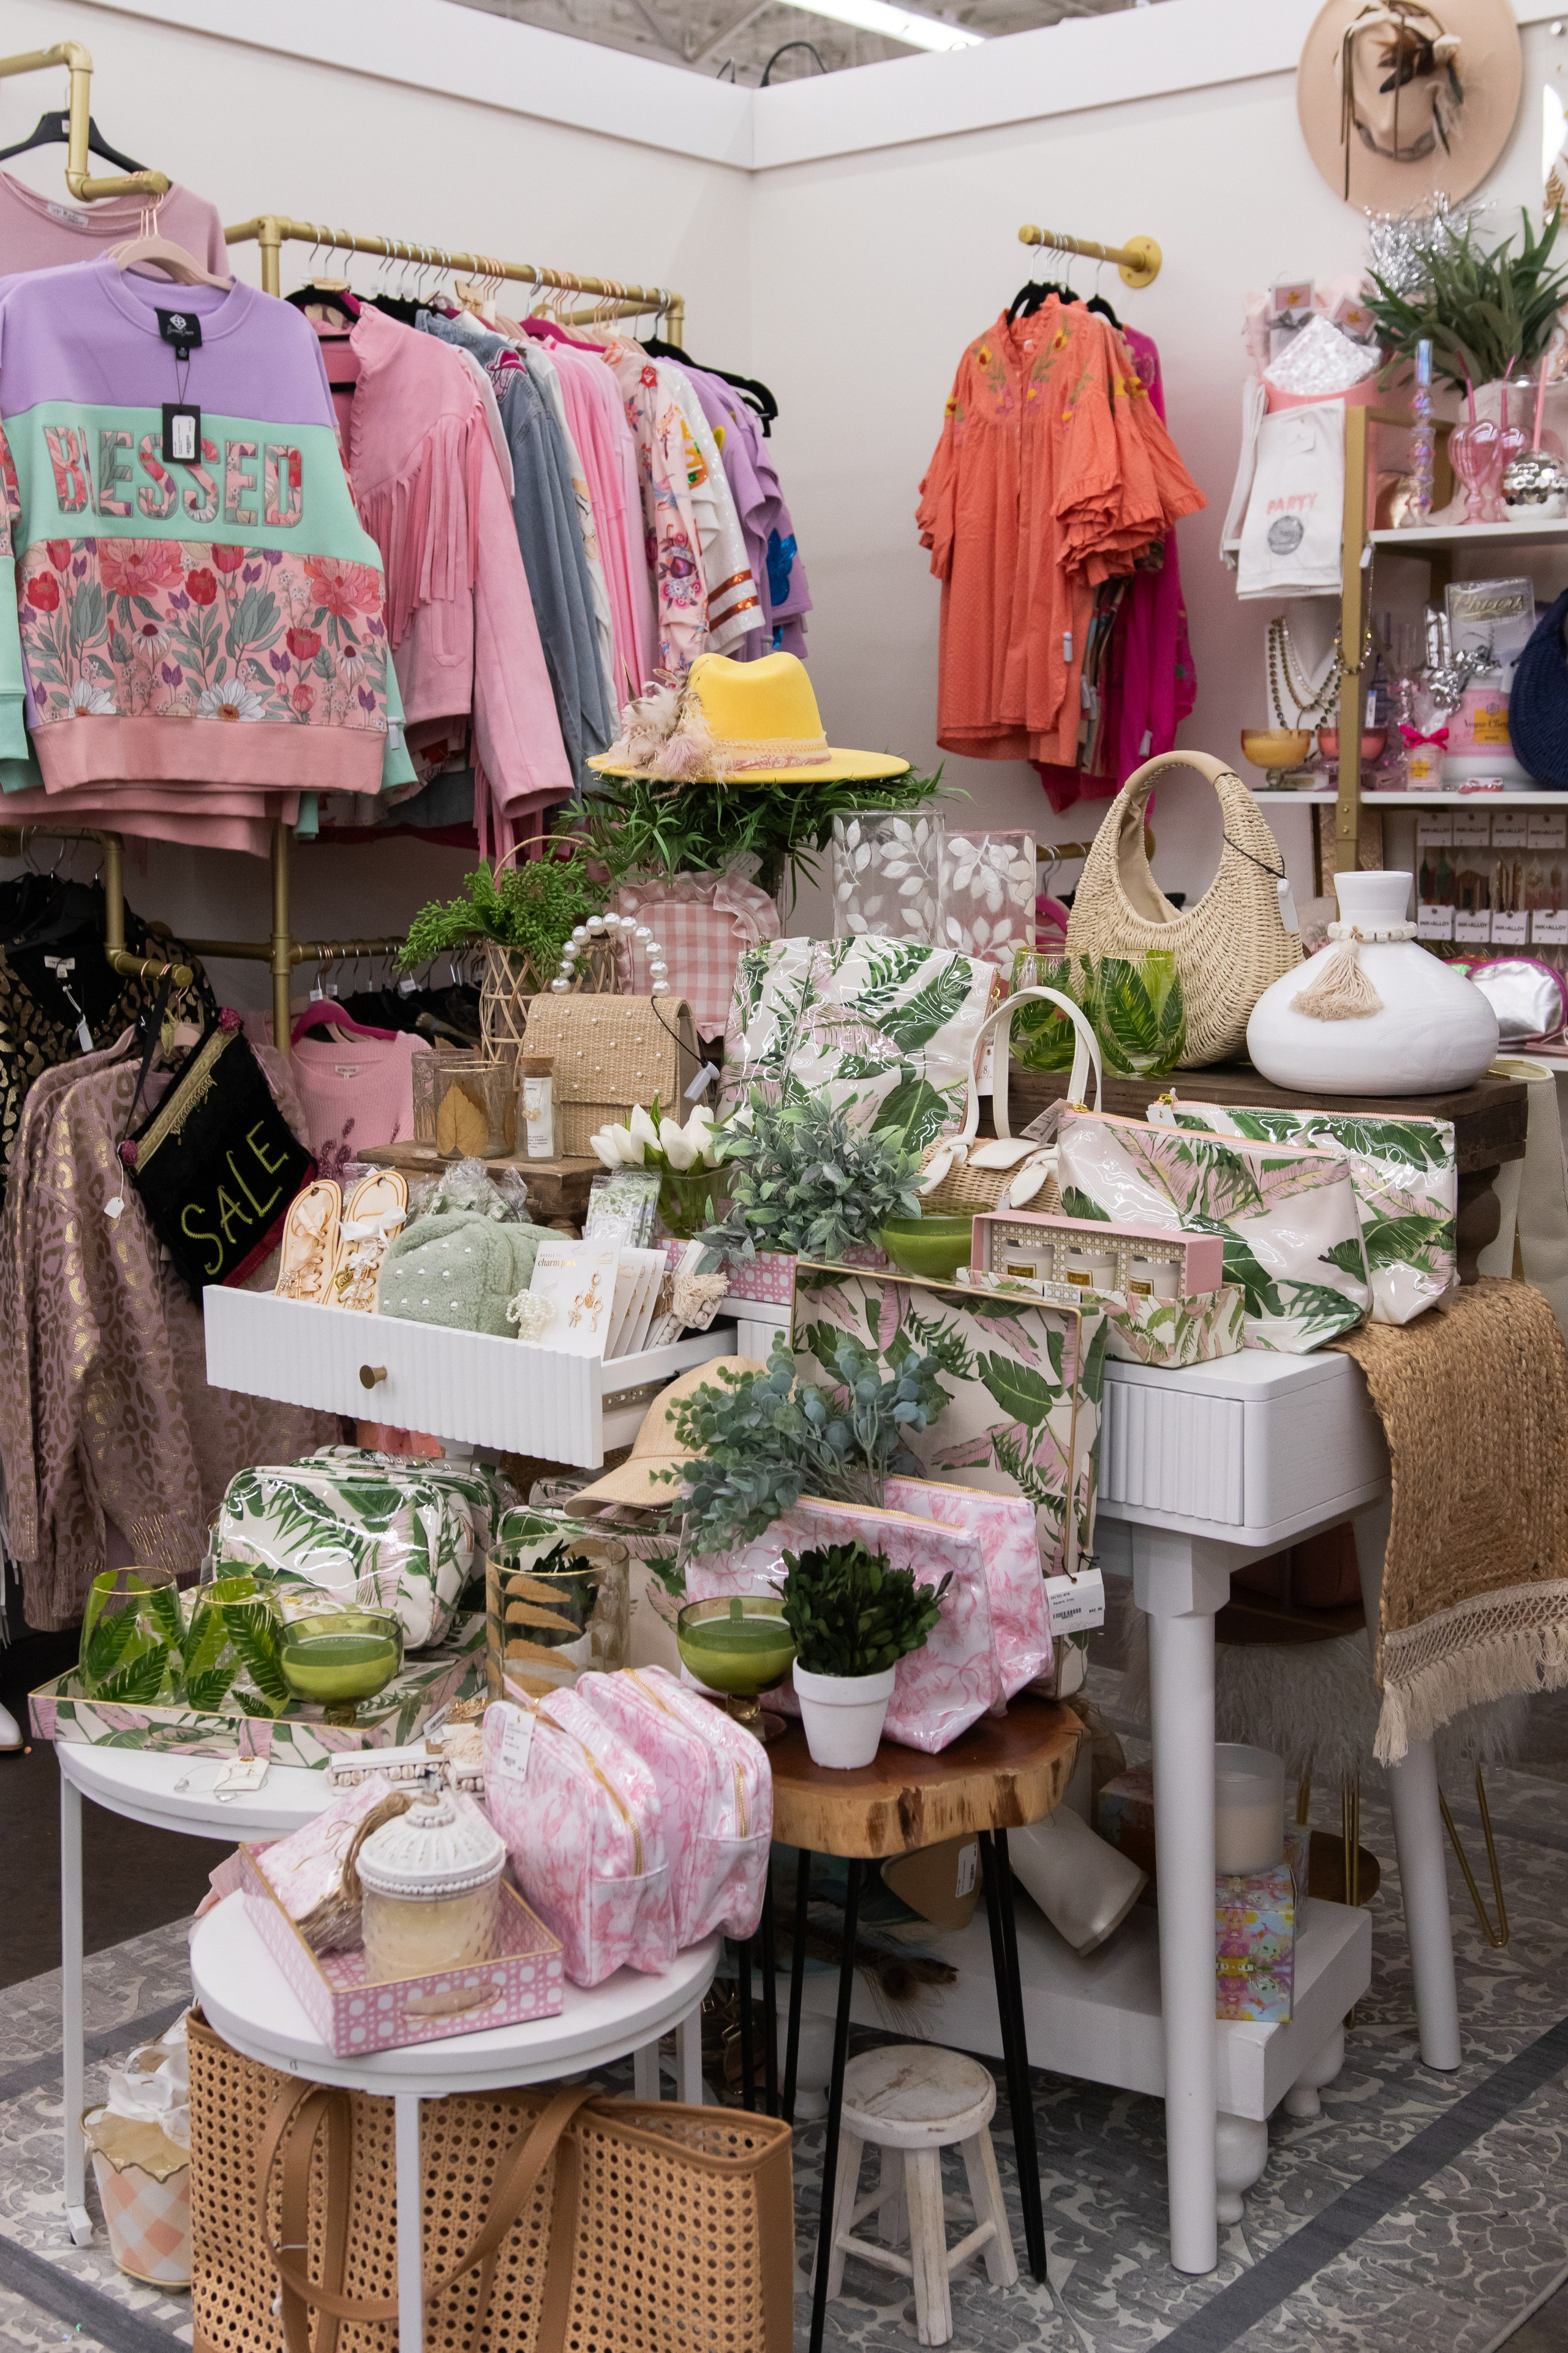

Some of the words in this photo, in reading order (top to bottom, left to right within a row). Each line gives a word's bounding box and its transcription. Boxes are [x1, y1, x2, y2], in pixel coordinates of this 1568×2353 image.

[1267, 493, 1318, 515] PARTY
[181, 1120, 290, 1275] SALE
[538, 1258, 559, 1267] charm
[560, 1259, 576, 1269] pack
